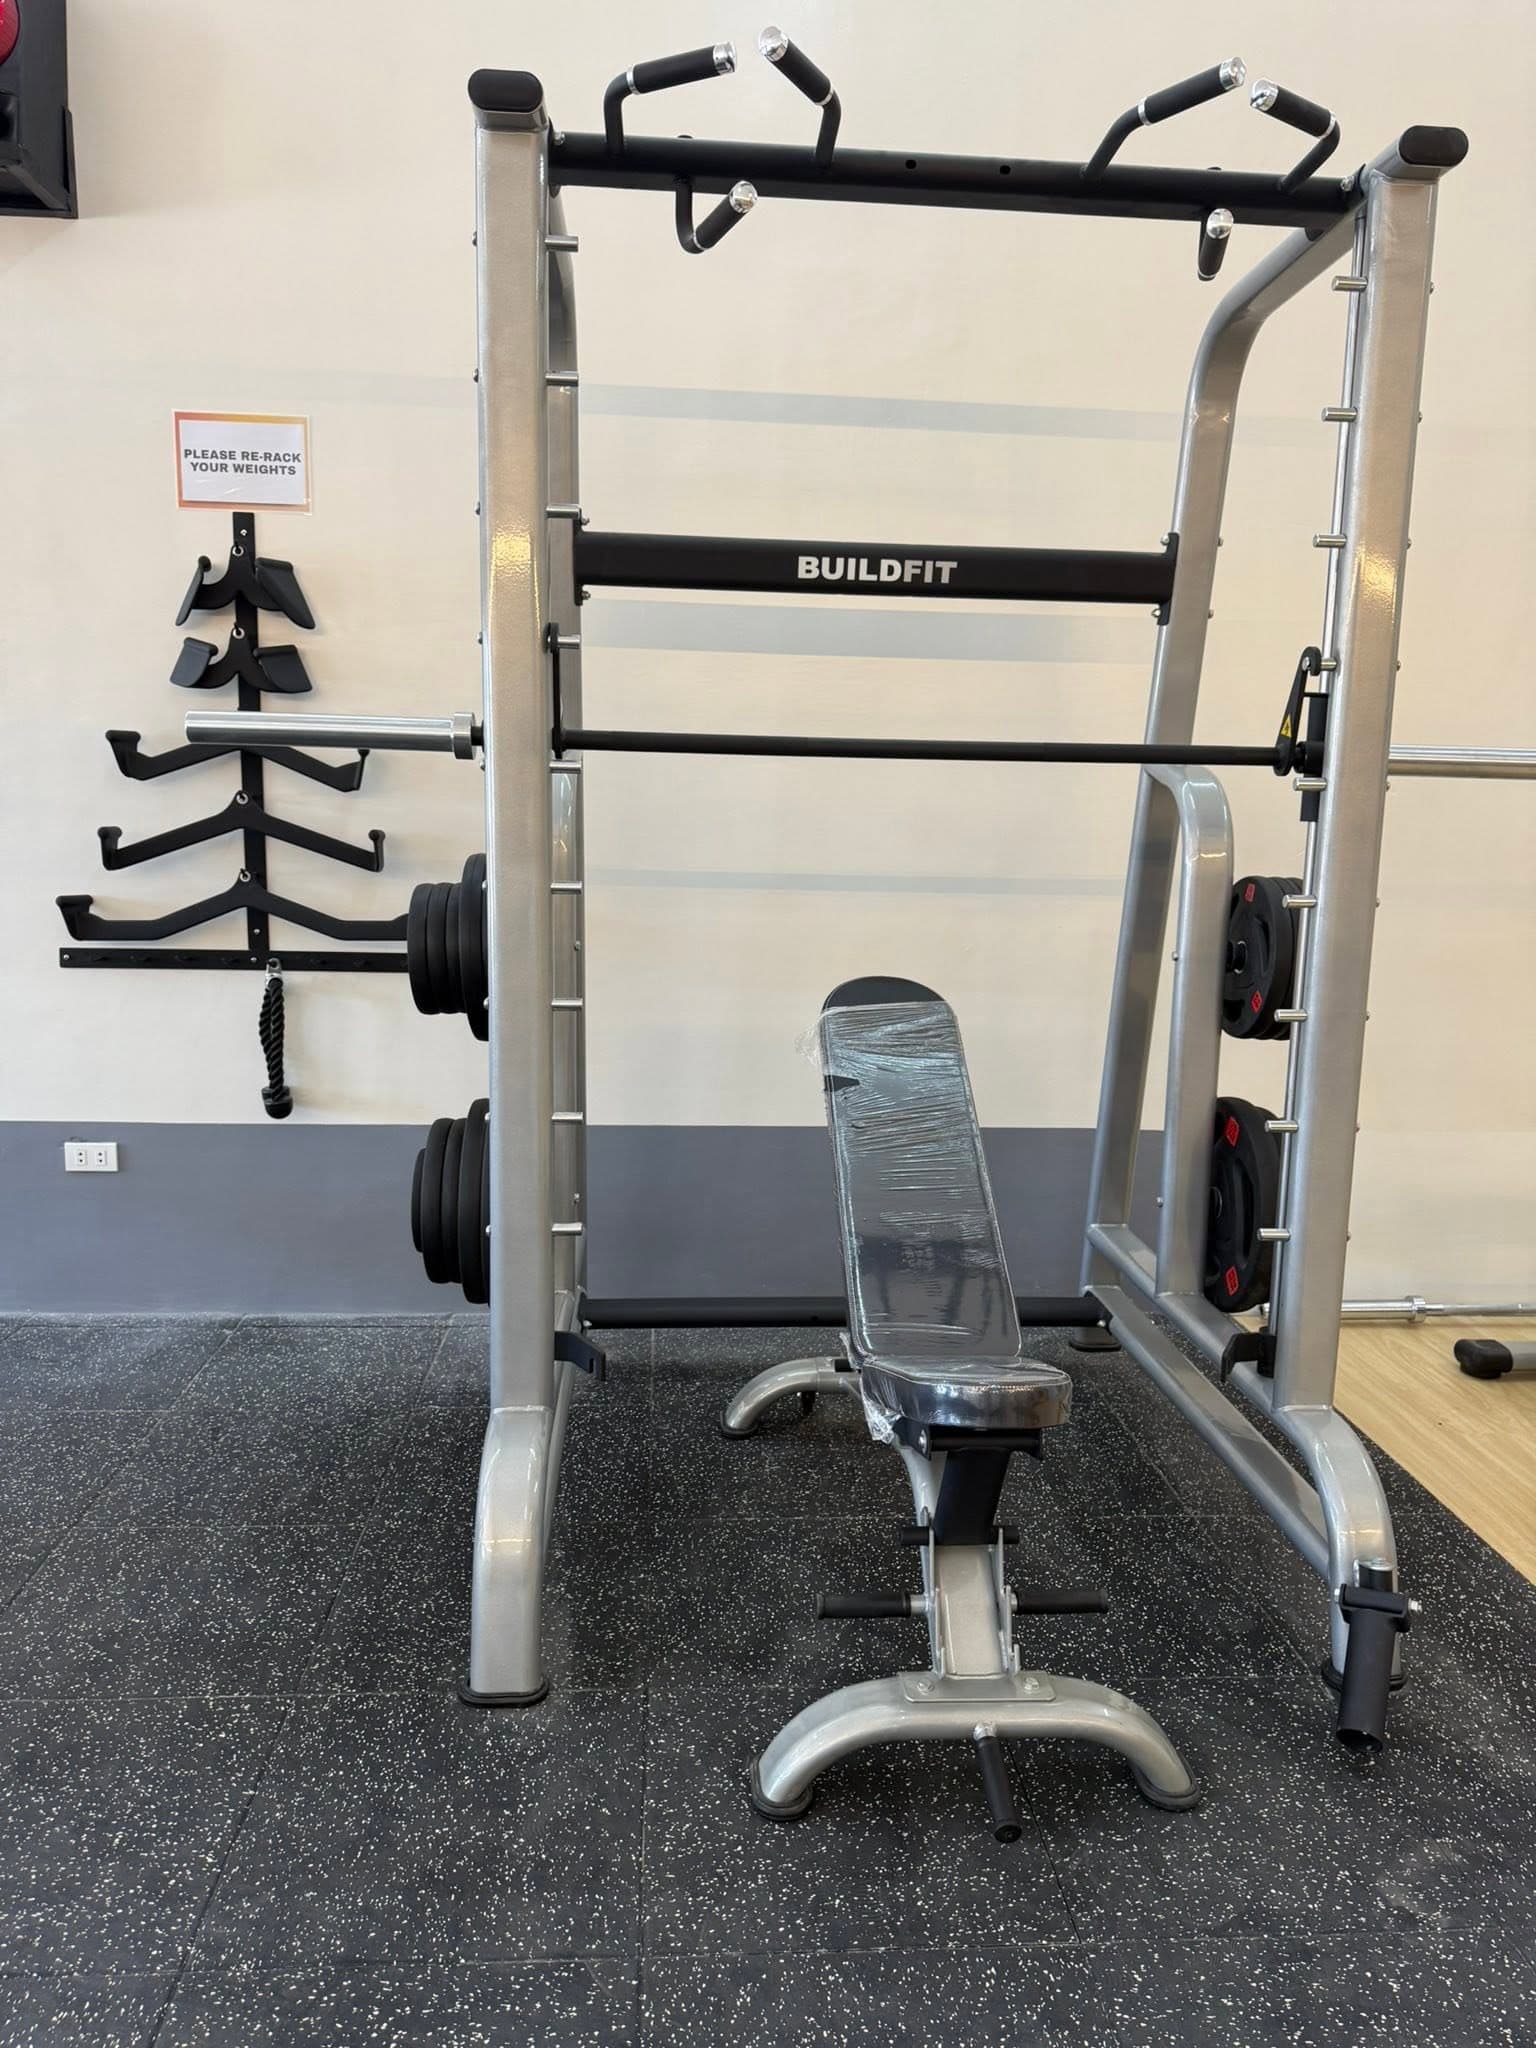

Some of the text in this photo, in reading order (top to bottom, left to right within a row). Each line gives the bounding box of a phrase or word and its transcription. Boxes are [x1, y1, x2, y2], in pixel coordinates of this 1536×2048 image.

[184, 449, 302, 463] PLEASE RE-RACK
[190, 462, 297, 475] YOUR WEIGHTS
[797, 555, 958, 584] BUILDFIT
